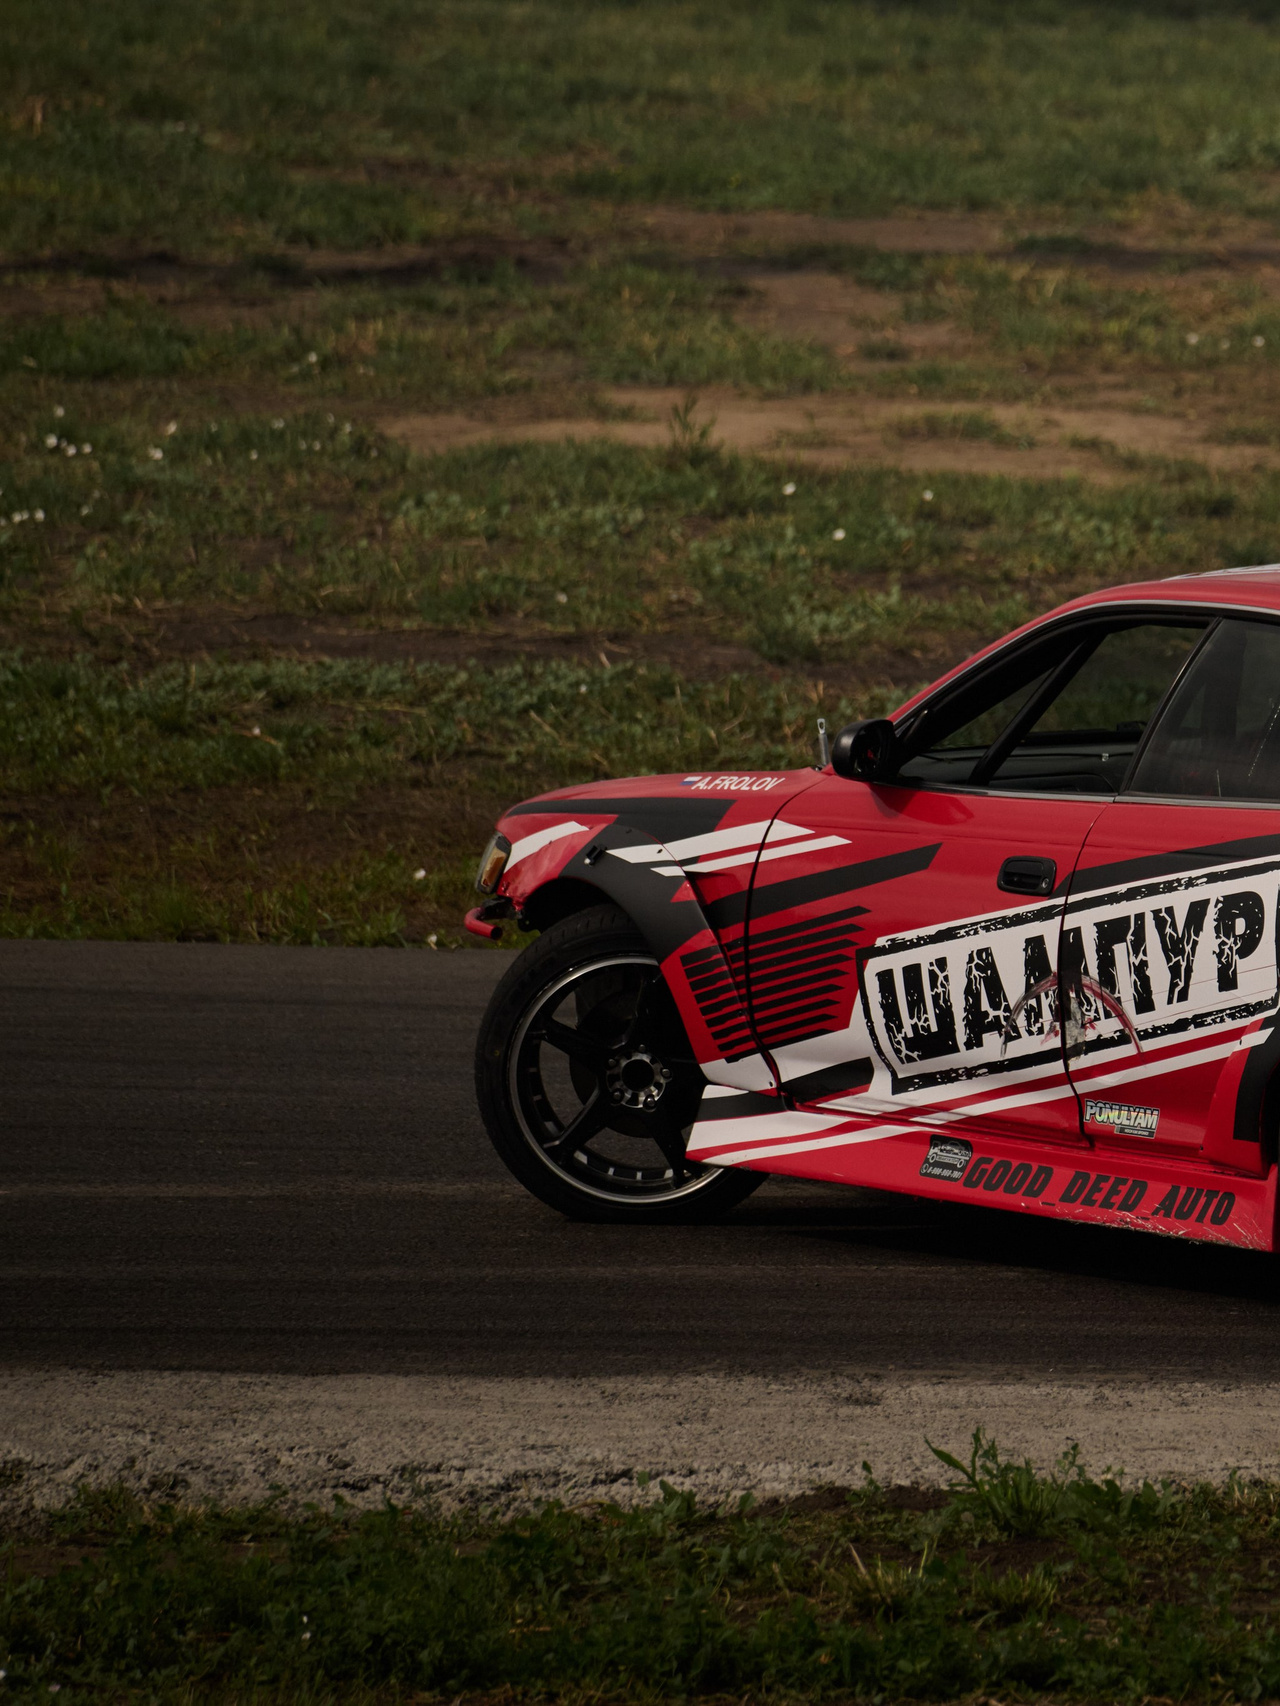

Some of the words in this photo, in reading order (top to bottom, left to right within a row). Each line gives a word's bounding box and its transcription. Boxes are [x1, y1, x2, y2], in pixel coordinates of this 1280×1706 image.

[691, 776, 786, 791] A.FROLOV
[875, 890, 1265, 1065] ШАМПУР
[1085, 1099, 1160, 1130] PONULYAM
